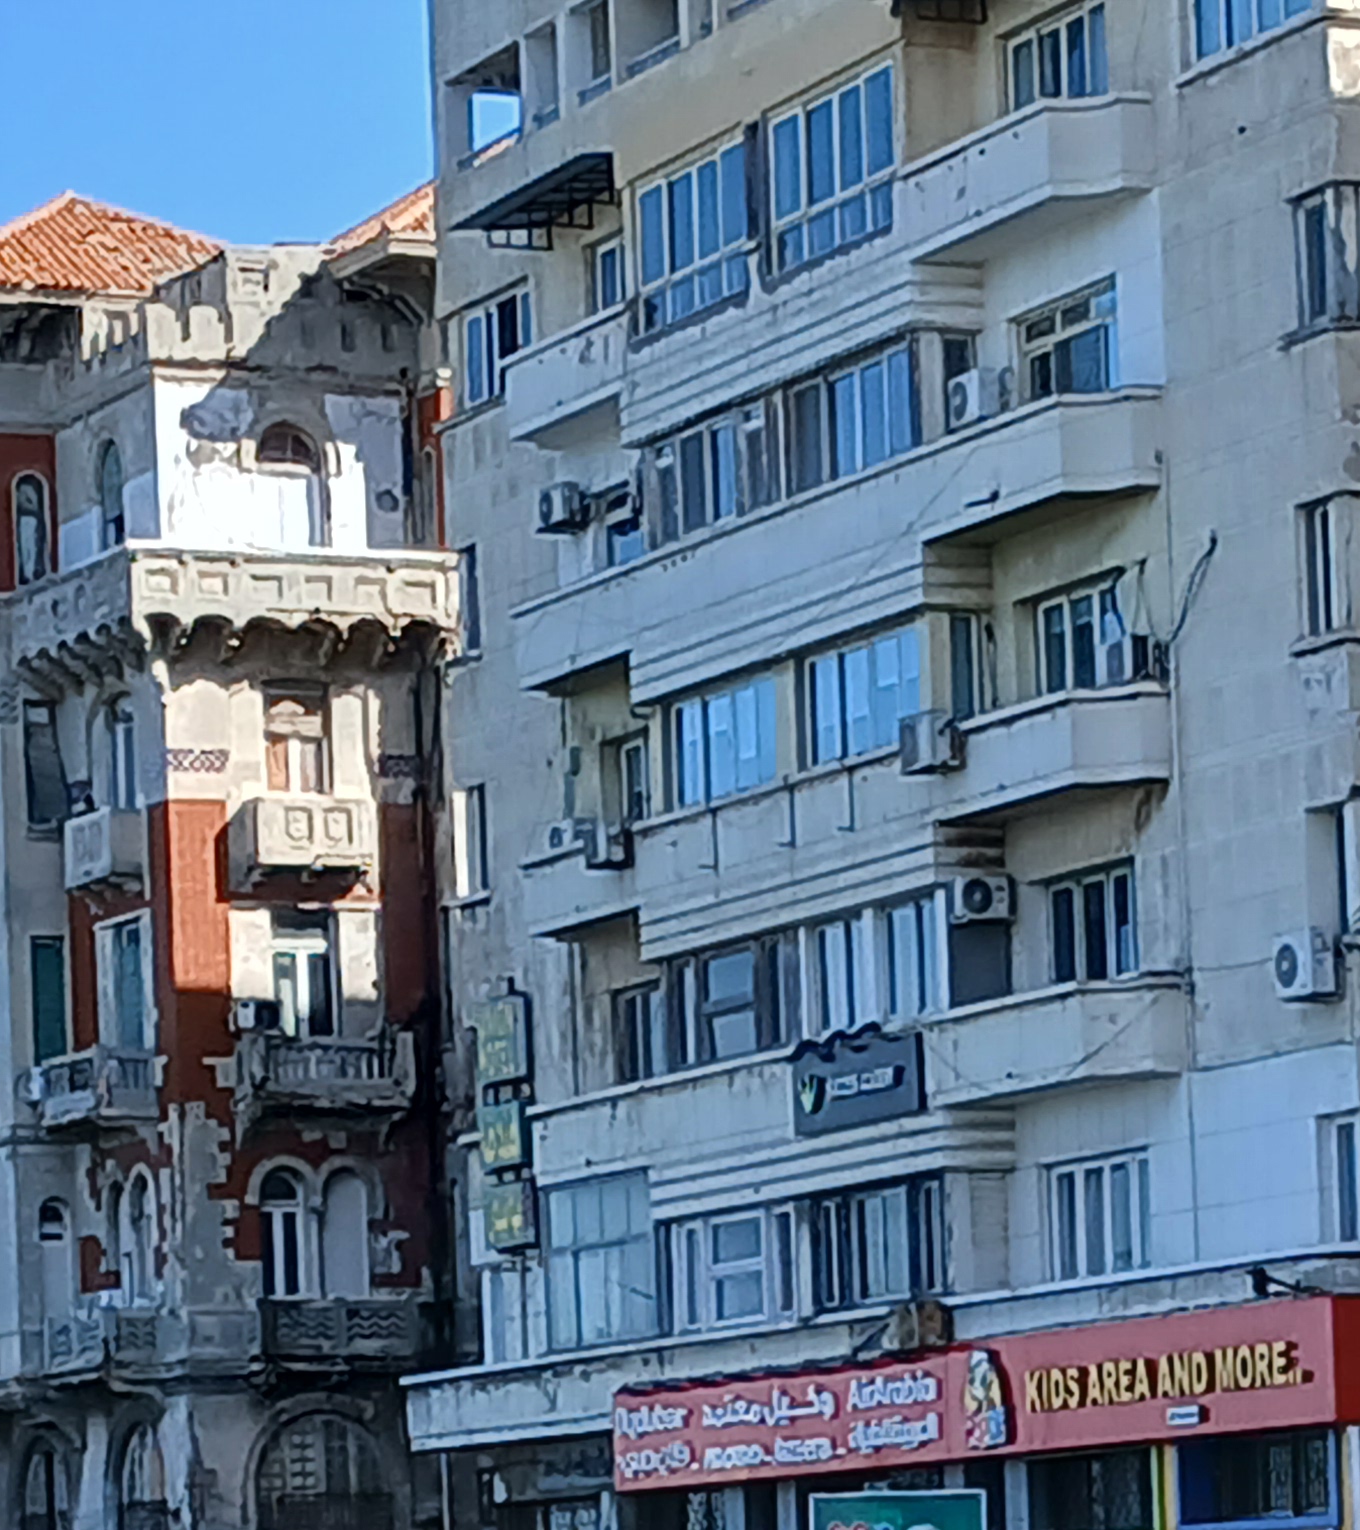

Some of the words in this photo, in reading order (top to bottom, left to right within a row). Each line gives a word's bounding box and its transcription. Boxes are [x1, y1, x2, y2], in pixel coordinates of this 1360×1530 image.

[1024, 1367, 1080, 1413] KIDS
[1087, 1357, 1150, 1405] AREA
[1157, 1350, 1207, 1397] AND
